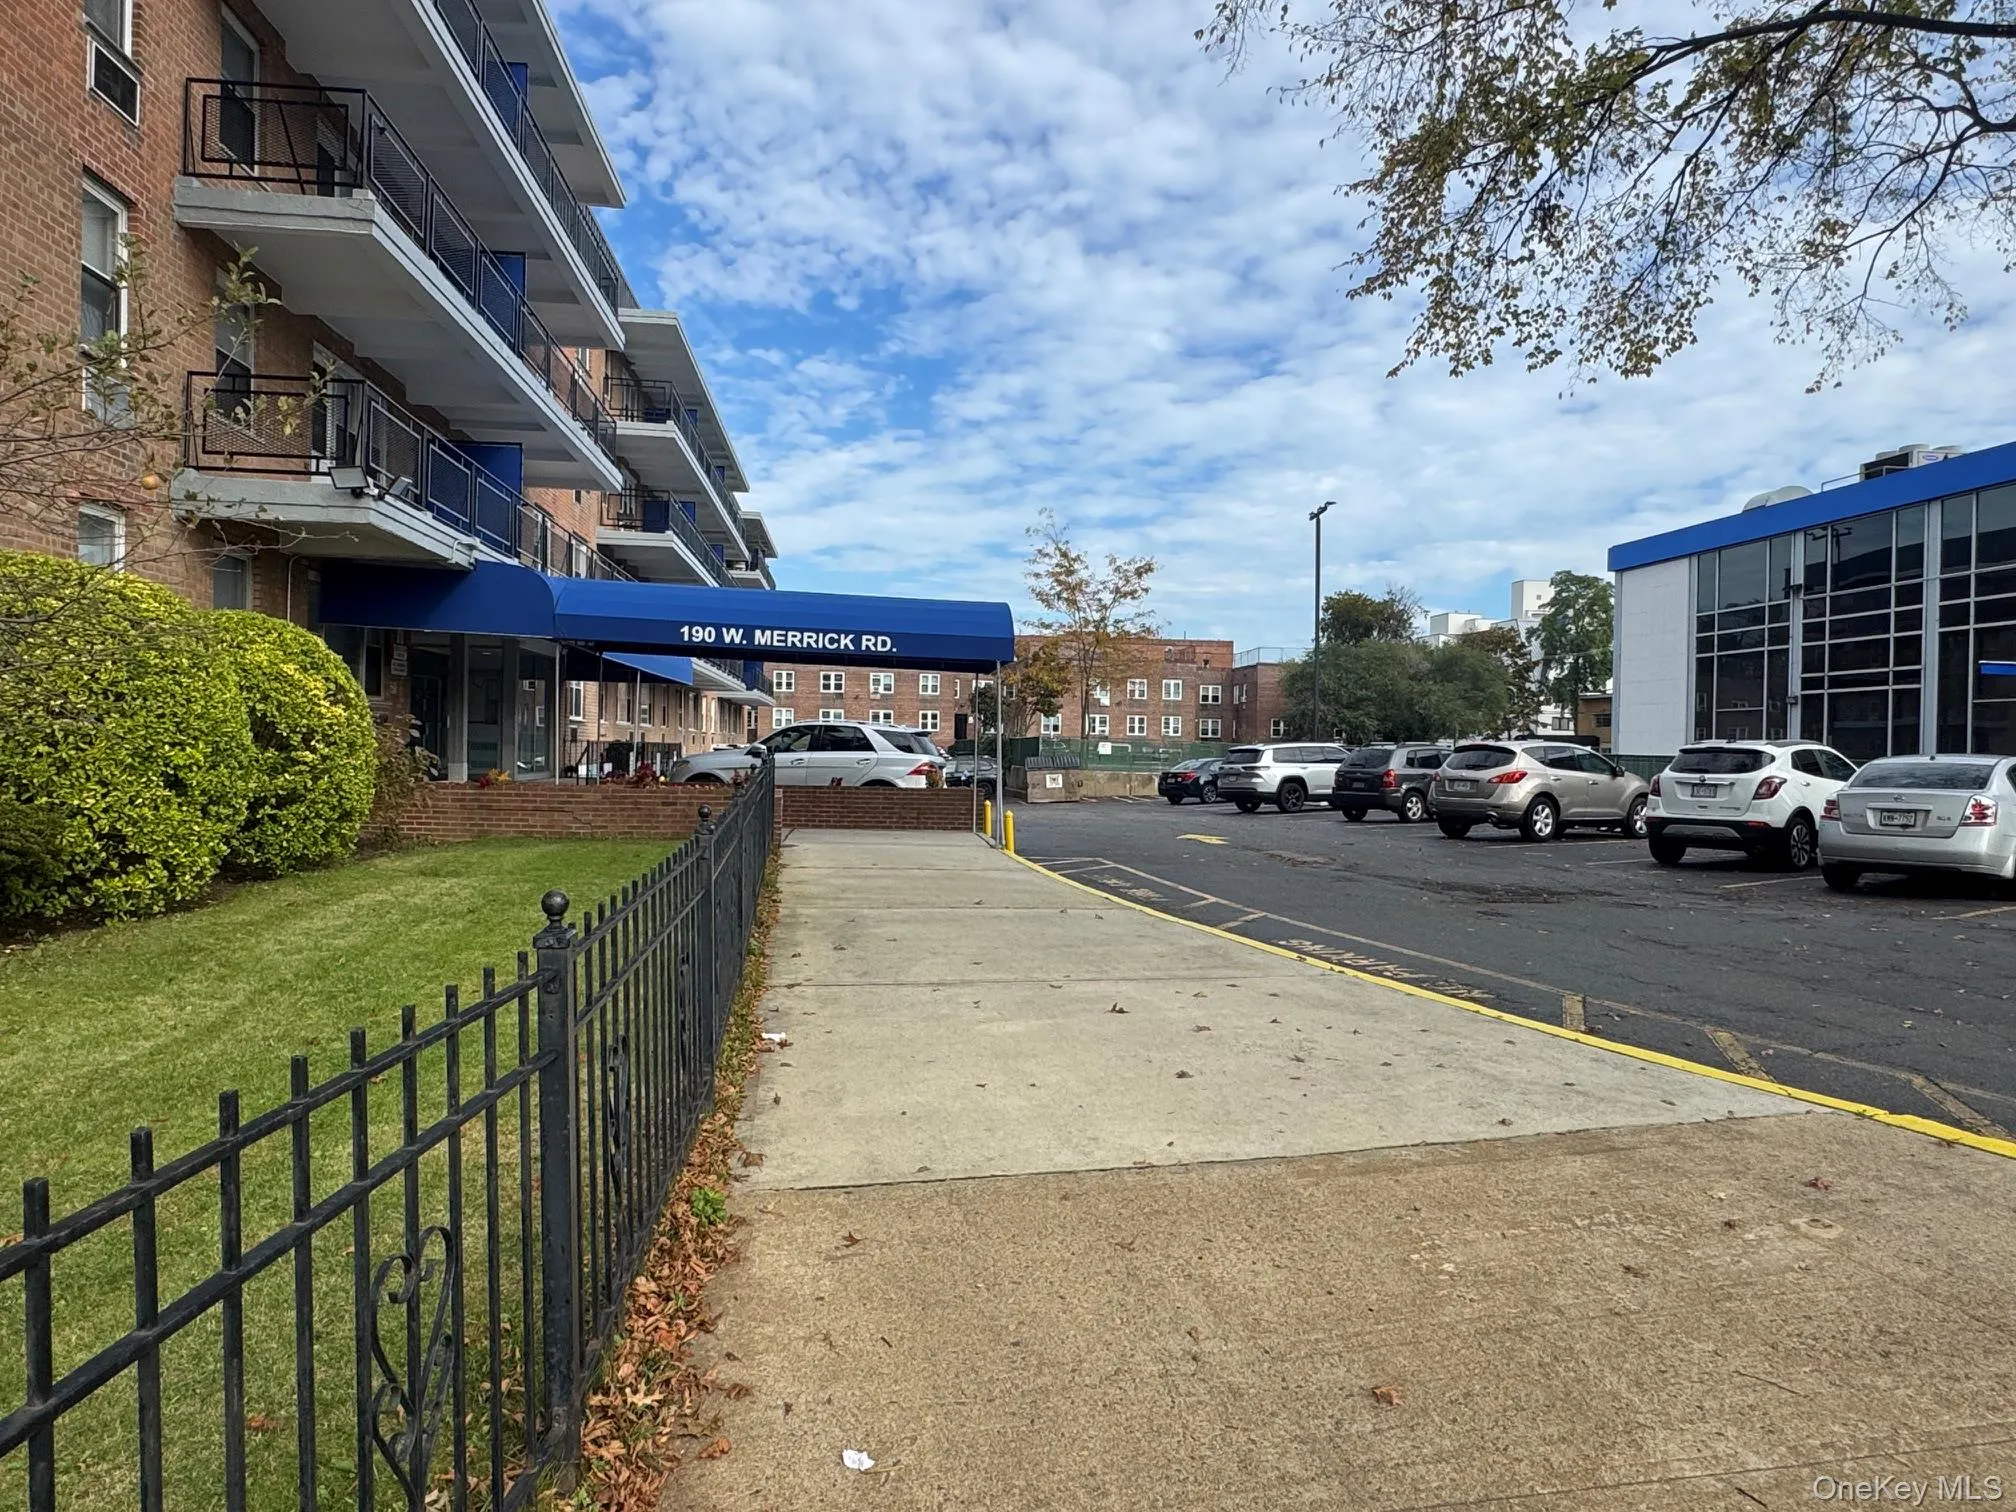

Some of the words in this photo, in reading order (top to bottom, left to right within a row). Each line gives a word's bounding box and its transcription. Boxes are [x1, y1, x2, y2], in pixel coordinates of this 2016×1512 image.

[679, 625, 716, 643] 190
[722, 627, 748, 645] W.
[754, 629, 855, 650] MERRICK
[861, 635, 898, 652] RD.
